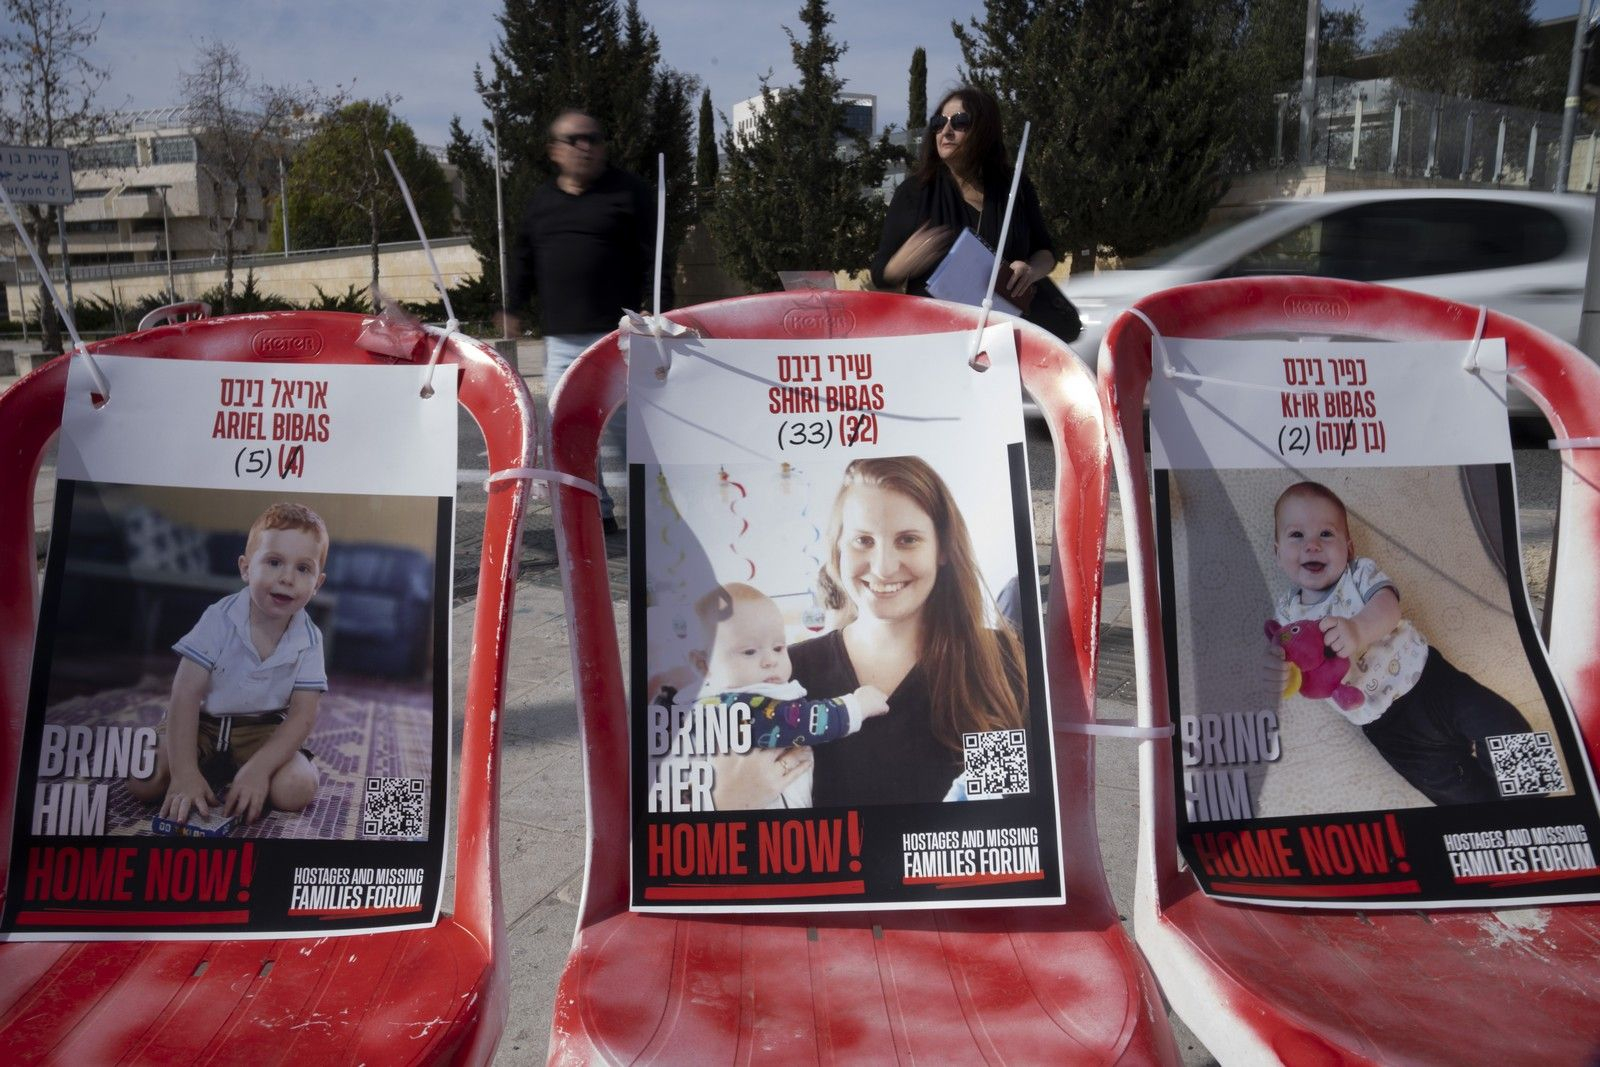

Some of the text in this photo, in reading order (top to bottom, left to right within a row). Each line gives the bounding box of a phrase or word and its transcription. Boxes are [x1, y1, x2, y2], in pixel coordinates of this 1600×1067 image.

[9, 153, 21, 165] בן
[28, 154, 59, 167] קרית
[5, 187, 42, 197] uryon
[778, 354, 872, 382] שירי ביבס
[1283, 358, 1367, 386] כפיר ביבס
[220, 378, 328, 409] אריאל ביבס
[769, 383, 884, 414] SHIRI BIBAS
[1324, 390, 1376, 418] BIBAS
[212, 411, 330, 442] ARIEL BIBAS
[778, 420, 833, 450] (33)
[1278, 425, 1310, 456] (2)
[235, 447, 272, 478] (5)
[648, 702, 751, 755] BRING
[1181, 710, 1281, 765] BRING
[38, 724, 158, 779] BRING
[648, 761, 715, 813] HER
[1184, 769, 1252, 823] HIM
[31, 783, 109, 836] HIM
[648, 810, 864, 877] HOME NOW!
[902, 827, 1038, 851] HOSTAGES AND MISSING
[1193, 813, 1411, 877] HOME NOW!
[1443, 824, 1588, 851] HOSTAGES AND MISSING
[25, 842, 255, 903] HOME NOW!
[294, 867, 424, 885] HOSTAGES AND MISSING
[903, 846, 1041, 878] FAMILIES FORUM
[1448, 843, 1597, 878] FAMILIES FORUM
[290, 885, 422, 910] FAMILIES FORUM
